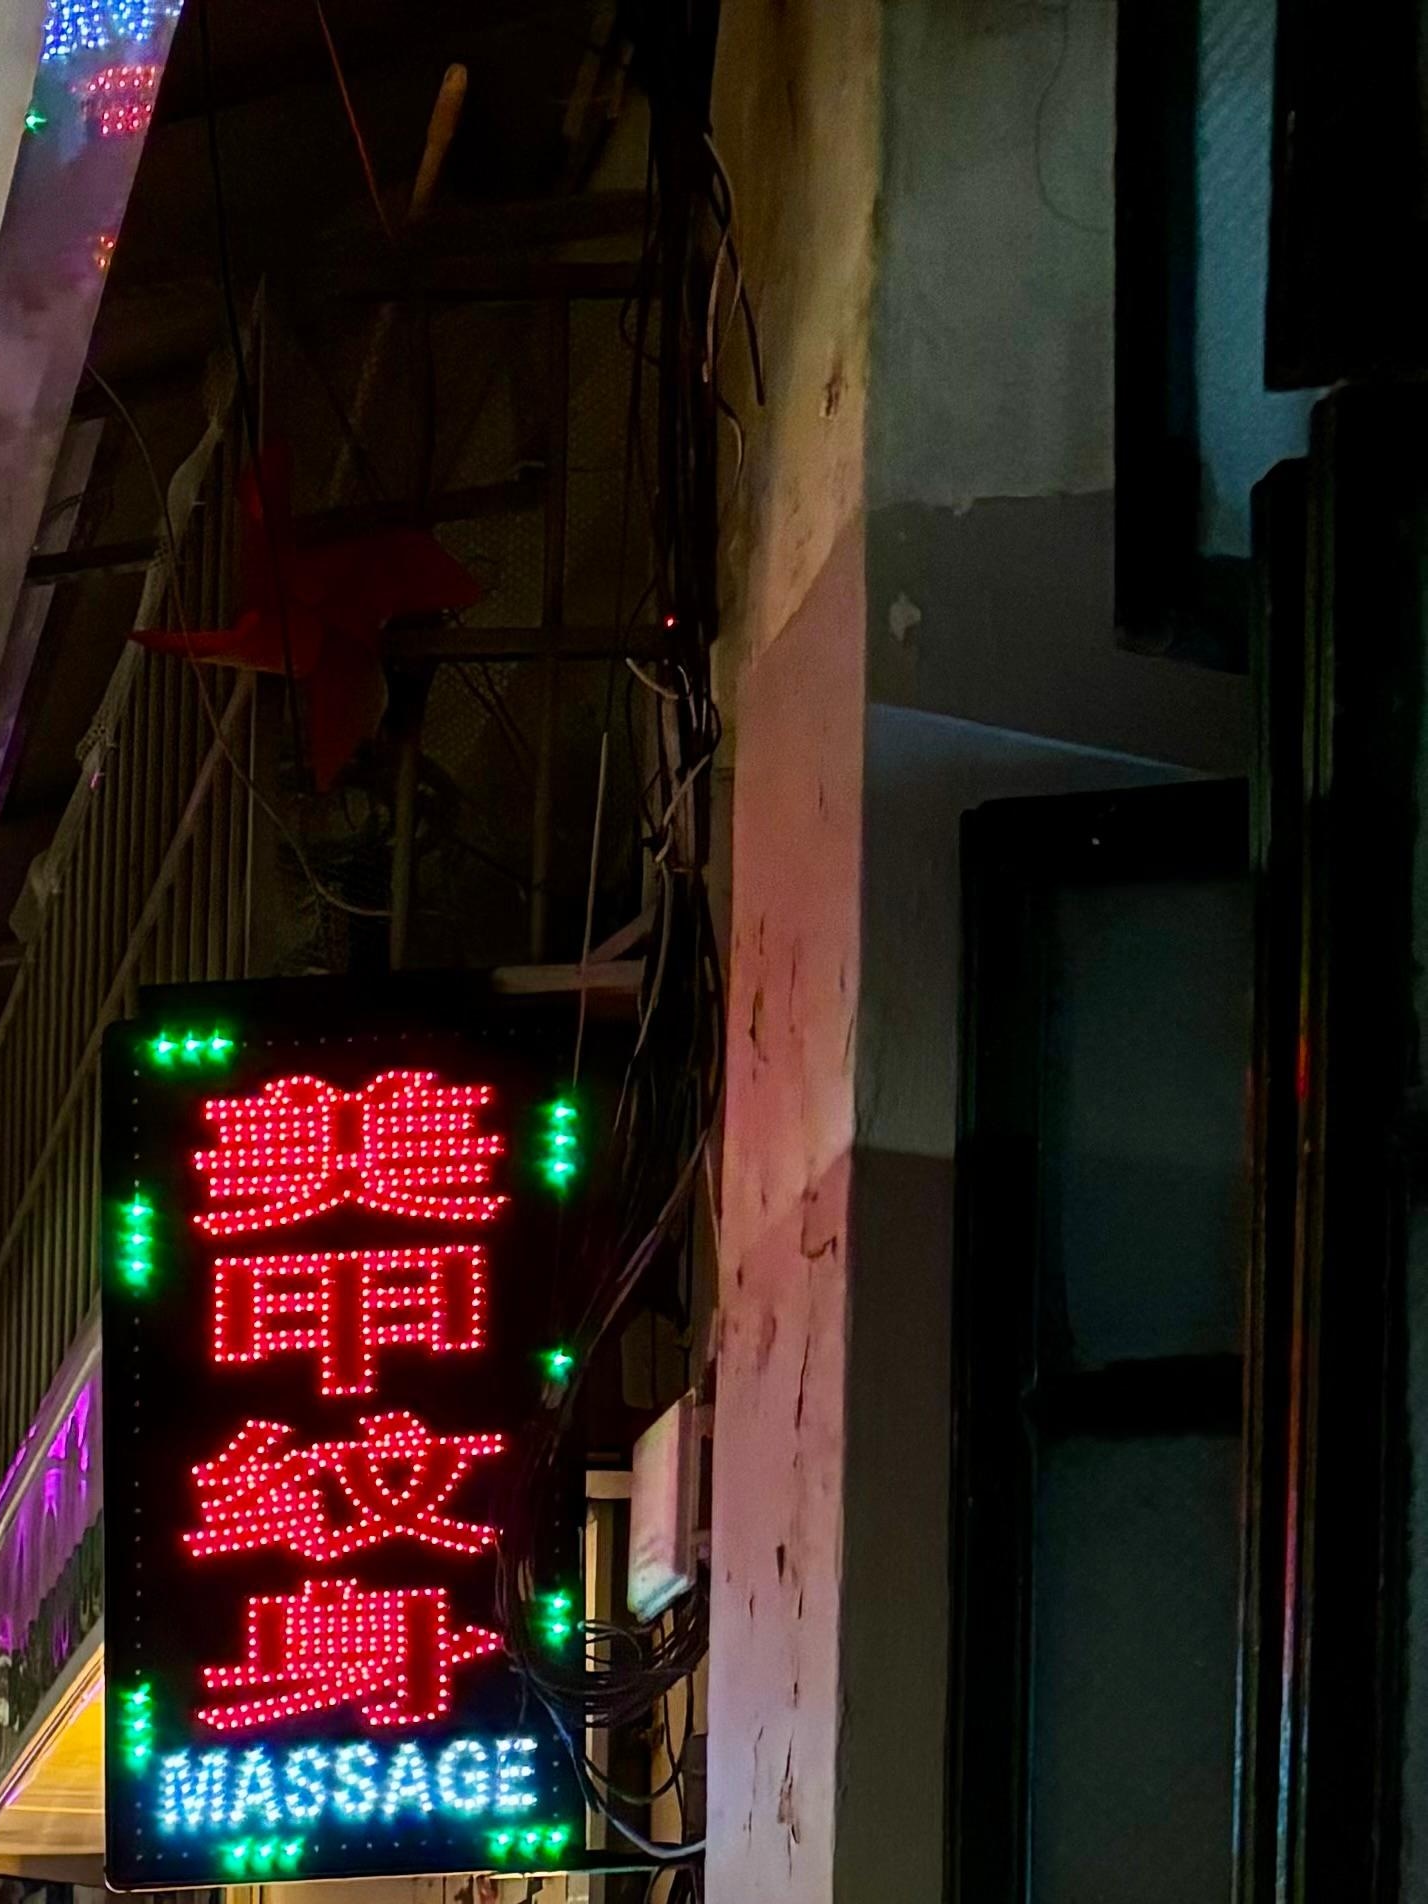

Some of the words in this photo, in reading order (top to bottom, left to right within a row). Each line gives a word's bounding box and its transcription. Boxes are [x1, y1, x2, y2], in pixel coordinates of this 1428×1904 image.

[182, 1069, 508, 1731] 美甲纹身
[158, 1737, 539, 1826] MASSAGE
